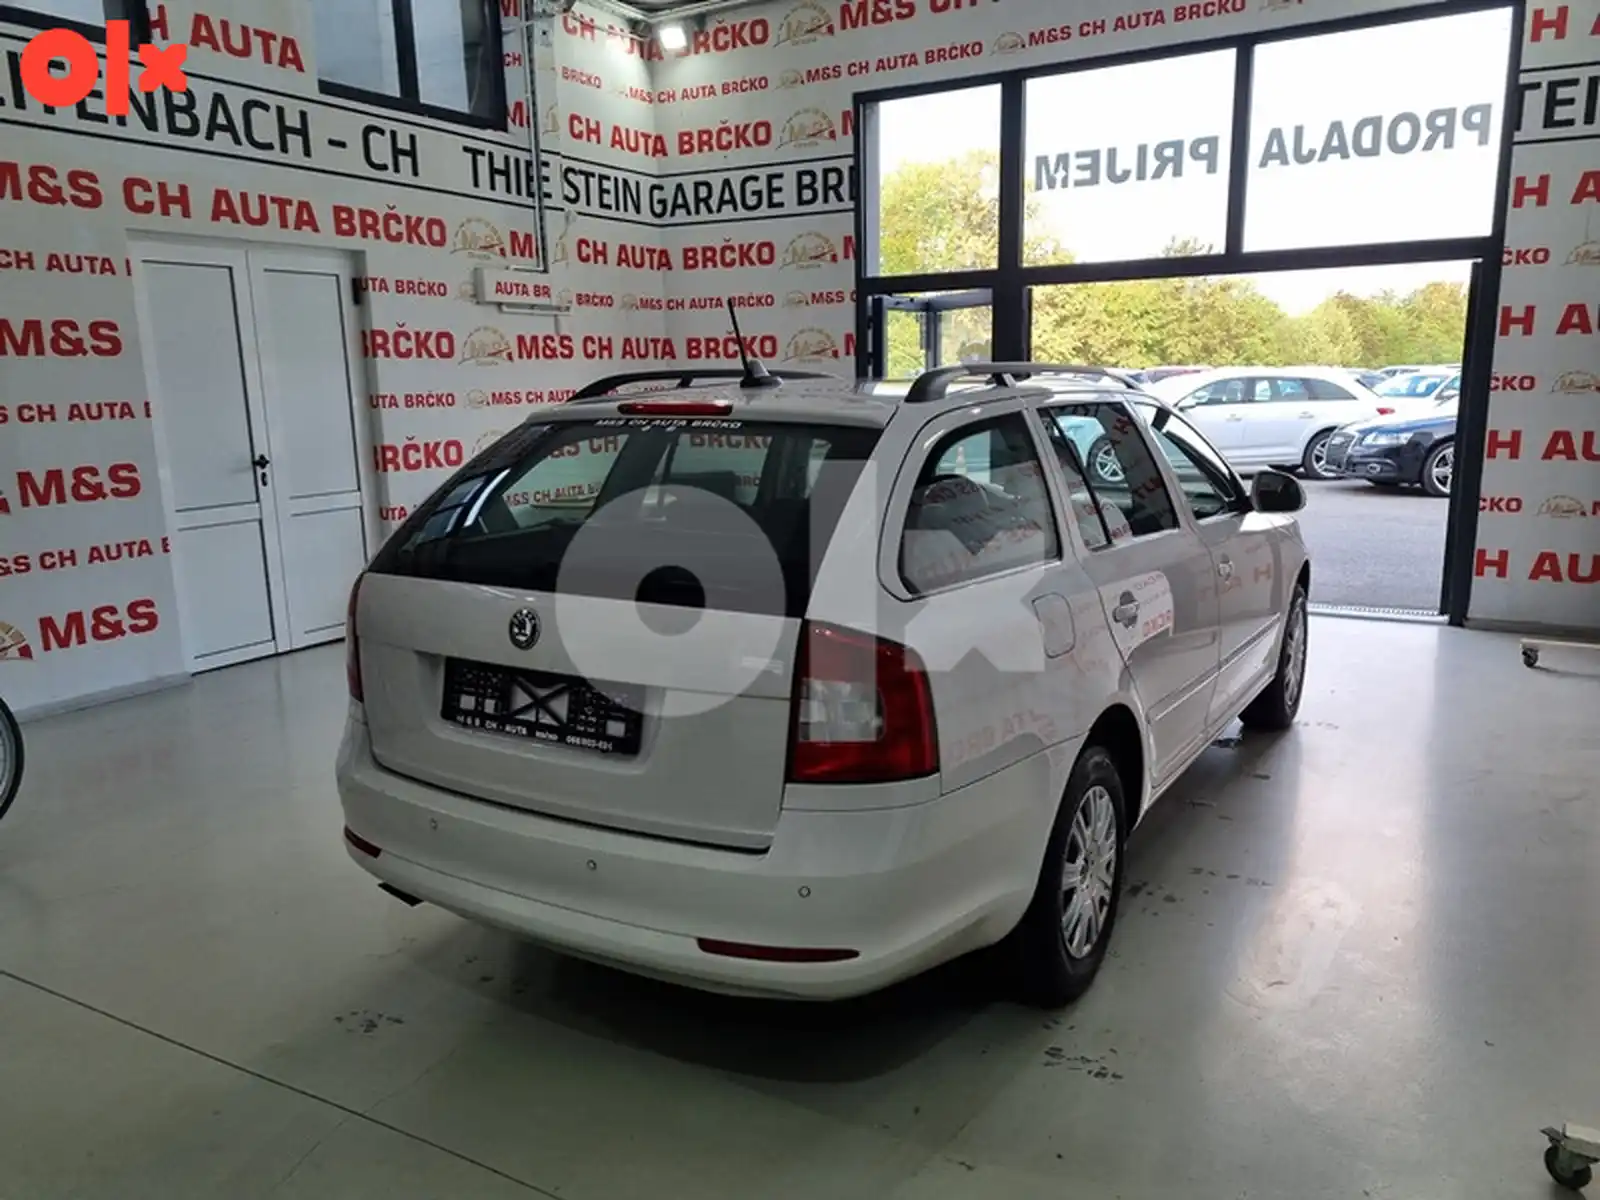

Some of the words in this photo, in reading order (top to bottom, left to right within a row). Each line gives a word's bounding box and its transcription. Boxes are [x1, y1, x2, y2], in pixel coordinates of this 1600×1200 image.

[839, 0, 916, 31] M&S
[1027, 25, 1071, 47] M&S
[1079, 17, 1105, 37] CH
[1113, 10, 1165, 32] AUTA
[1530, 5, 1569, 43] H
[190, 13, 305, 73] AUTA
[676, 18, 769, 57] RČKO
[806, 66, 841, 84] M&S
[847, 60, 870, 77] CH
[875, 53, 919, 71] AUTA
[657, 91, 676, 103] CH
[681, 85, 717, 101] AUTA
[361, 124, 419, 178] CH
[568, 113, 601, 144] CH
[609, 124, 669, 158] AUTA
[677, 119, 772, 155] BRČKO
[0, 161, 103, 209] M&S
[123, 177, 191, 219] CH
[211, 188, 321, 234] AUTA
[332, 204, 447, 247] BRČKO
[649, 173, 784, 218] GARAGE
[796, 166, 856, 206] BR
[1511, 174, 1550, 209] H
[46, 253, 117, 276] AUTA
[576, 238, 608, 266] CH
[616, 243, 673, 271] AUTA
[682, 237, 775, 270] BRČKO
[495, 281, 530, 298] AUTA
[639, 297, 663, 310] M&S
[667, 297, 685, 310] CH
[689, 296, 723, 310] AUTA
[810, 290, 845, 305] M&S
[1499, 305, 1536, 336] H
[1555, 304, 1600, 334] A
[0, 319, 122, 358] M&S
[517, 334, 574, 360] M&S
[582, 335, 615, 360] CH
[621, 337, 677, 360] AUTA
[686, 331, 778, 360] BRČKO
[17, 404, 56, 423] CH
[68, 402, 135, 422] AUTA
[491, 390, 521, 405] M&S
[526, 390, 545, 403] CH
[548, 389, 577, 403] AUT
[1486, 430, 1522, 459] H
[16, 463, 141, 507] M&S
[39, 548, 77, 571] CH
[87, 540, 153, 564] AUTA
[1475, 549, 1509, 579] H
[38, 598, 159, 653] M&S
